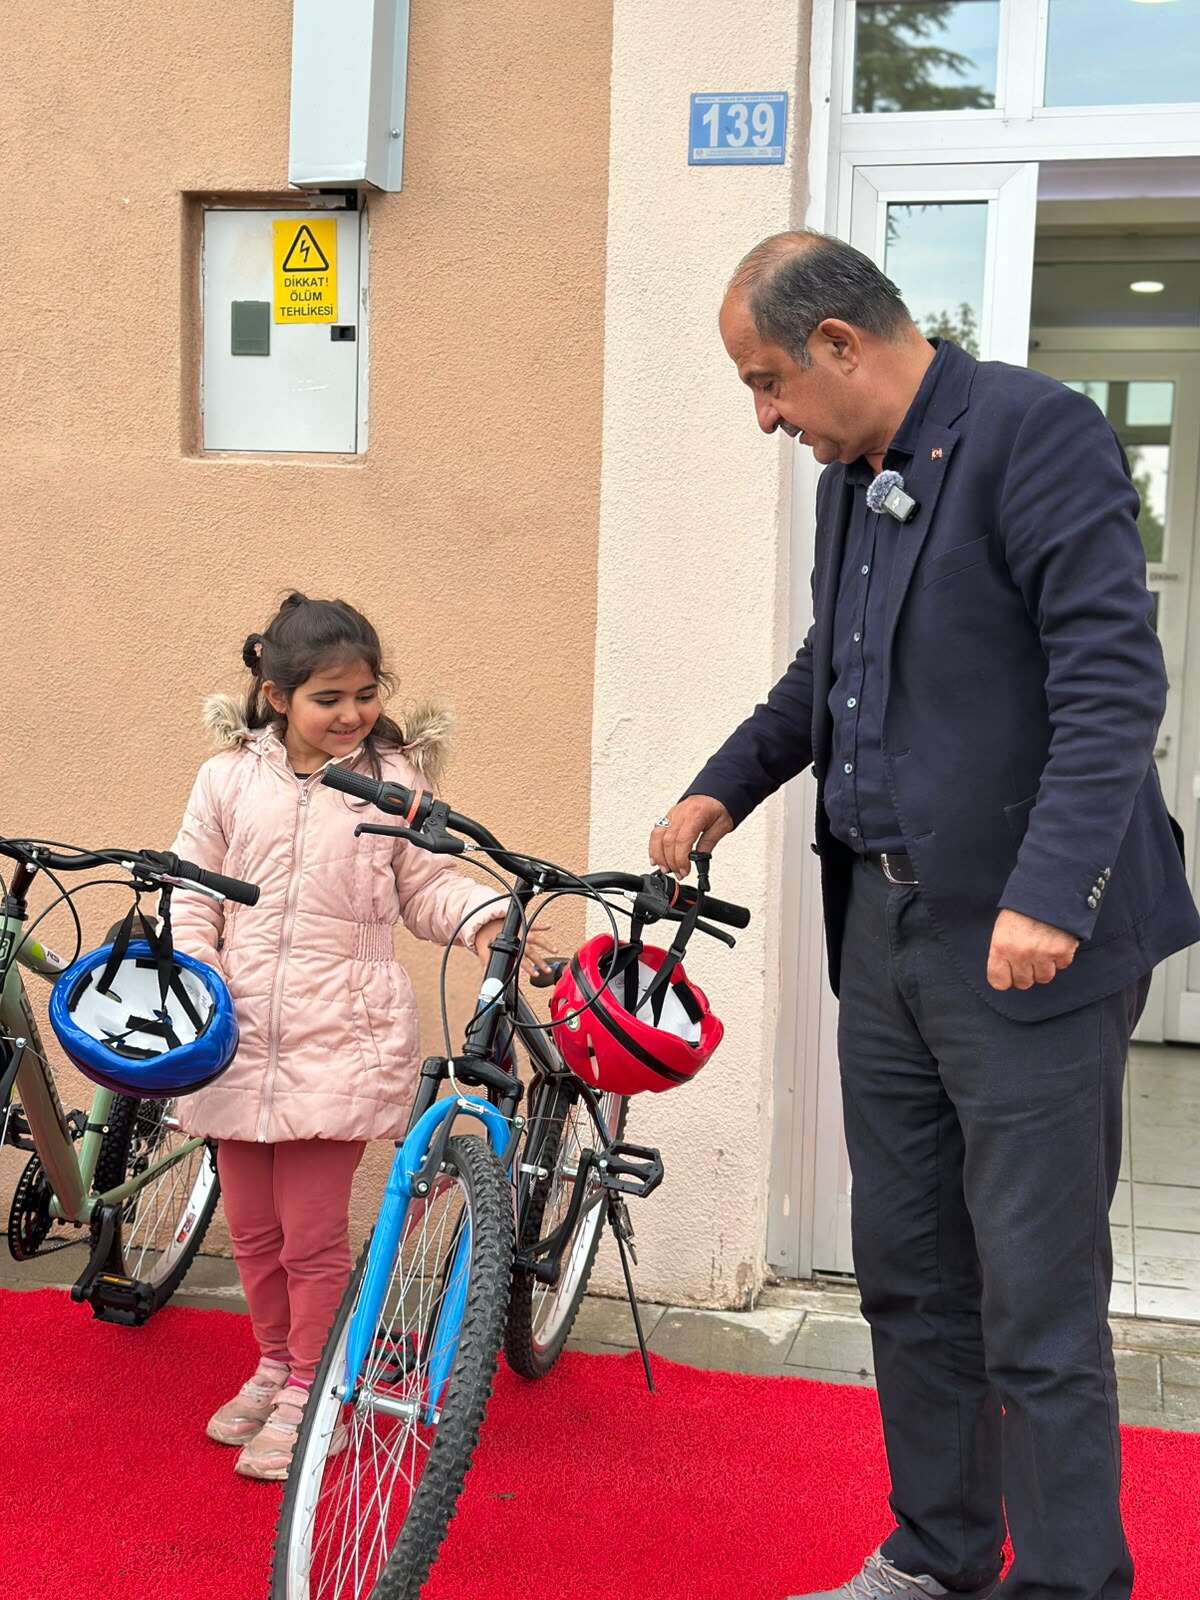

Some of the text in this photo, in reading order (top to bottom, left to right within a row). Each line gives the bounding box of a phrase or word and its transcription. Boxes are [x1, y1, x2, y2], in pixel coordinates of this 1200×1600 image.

[702, 103, 775, 147] 139
[284, 275, 329, 287] DİKKAT!
[290, 289, 322, 301] ÖLÜM
[280, 304, 333, 316] TEHLİKESİ
